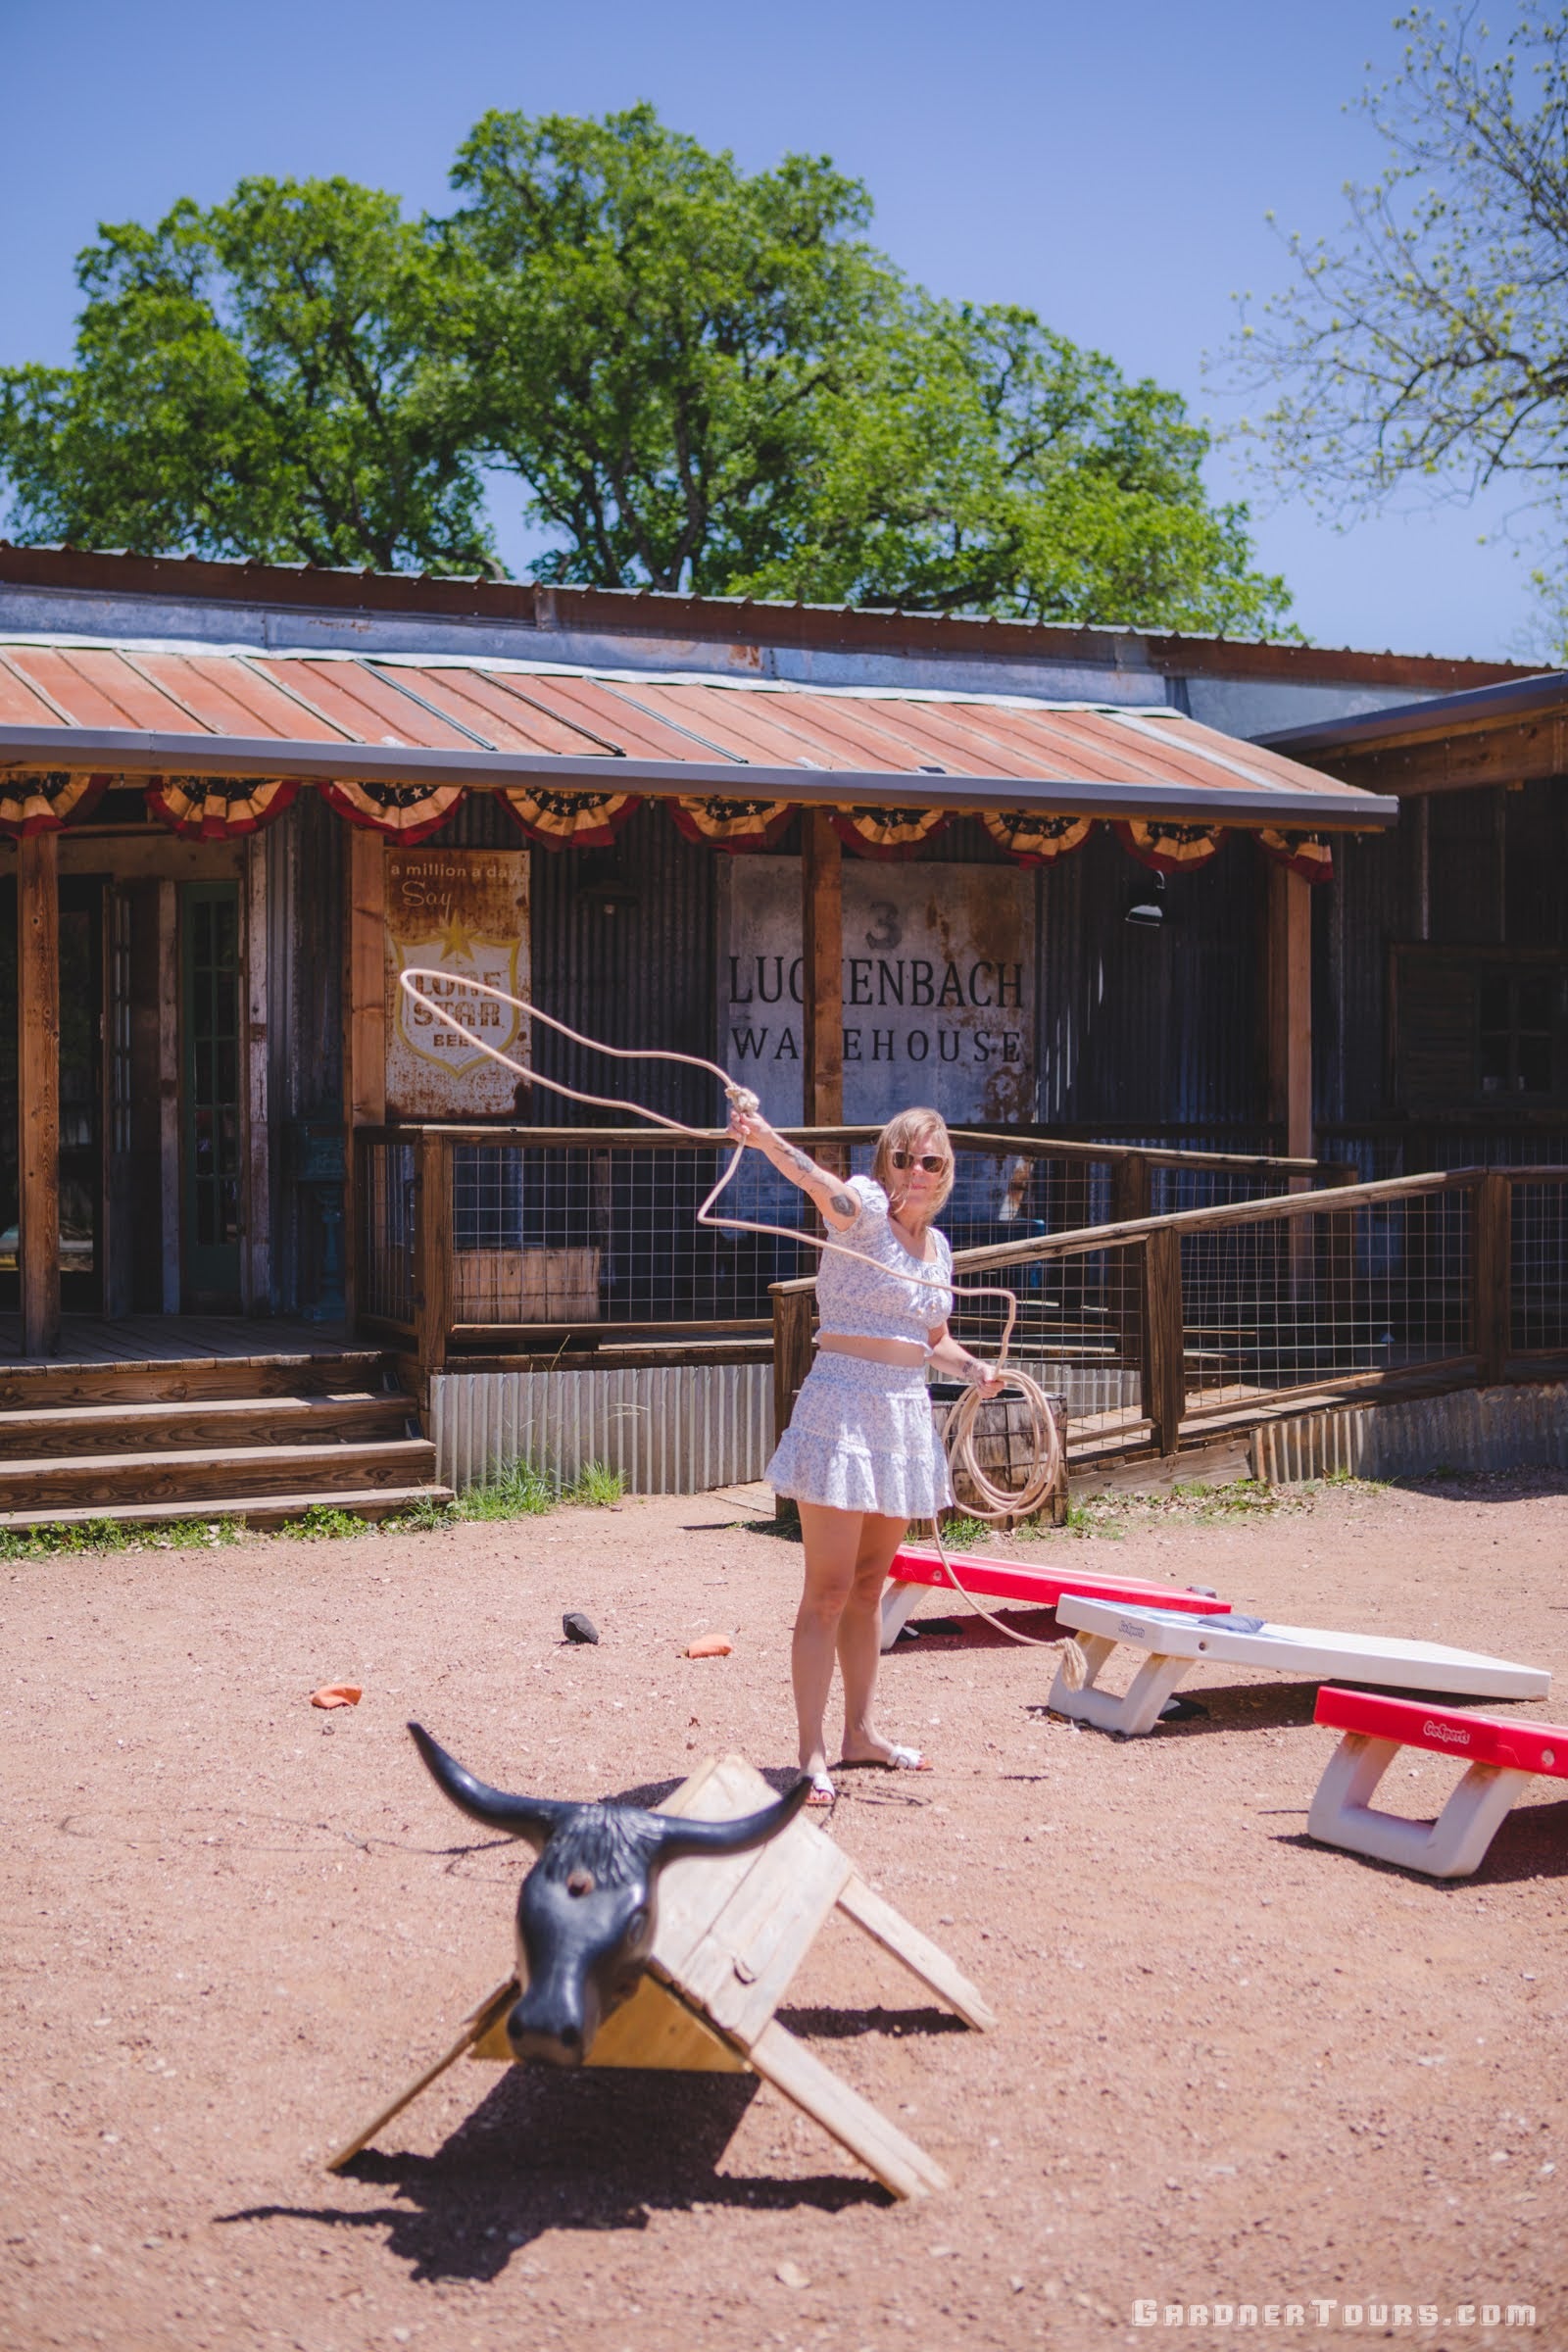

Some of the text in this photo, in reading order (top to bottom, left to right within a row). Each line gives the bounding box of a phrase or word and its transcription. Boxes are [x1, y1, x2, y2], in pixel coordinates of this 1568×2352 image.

[391, 864, 400, 875] a
[406, 862, 466, 877] million
[471, 867, 481, 878] a
[402, 880, 451, 920] Say
[865, 901, 903, 950] 3
[415, 971, 502, 997] LONE
[728, 956, 1023, 1008] LUCENBACH
[414, 1002, 501, 1027] STAR
[731, 1028, 1021, 1062] WAEHOUSE
[1423, 1720, 1470, 1744] GoSports
